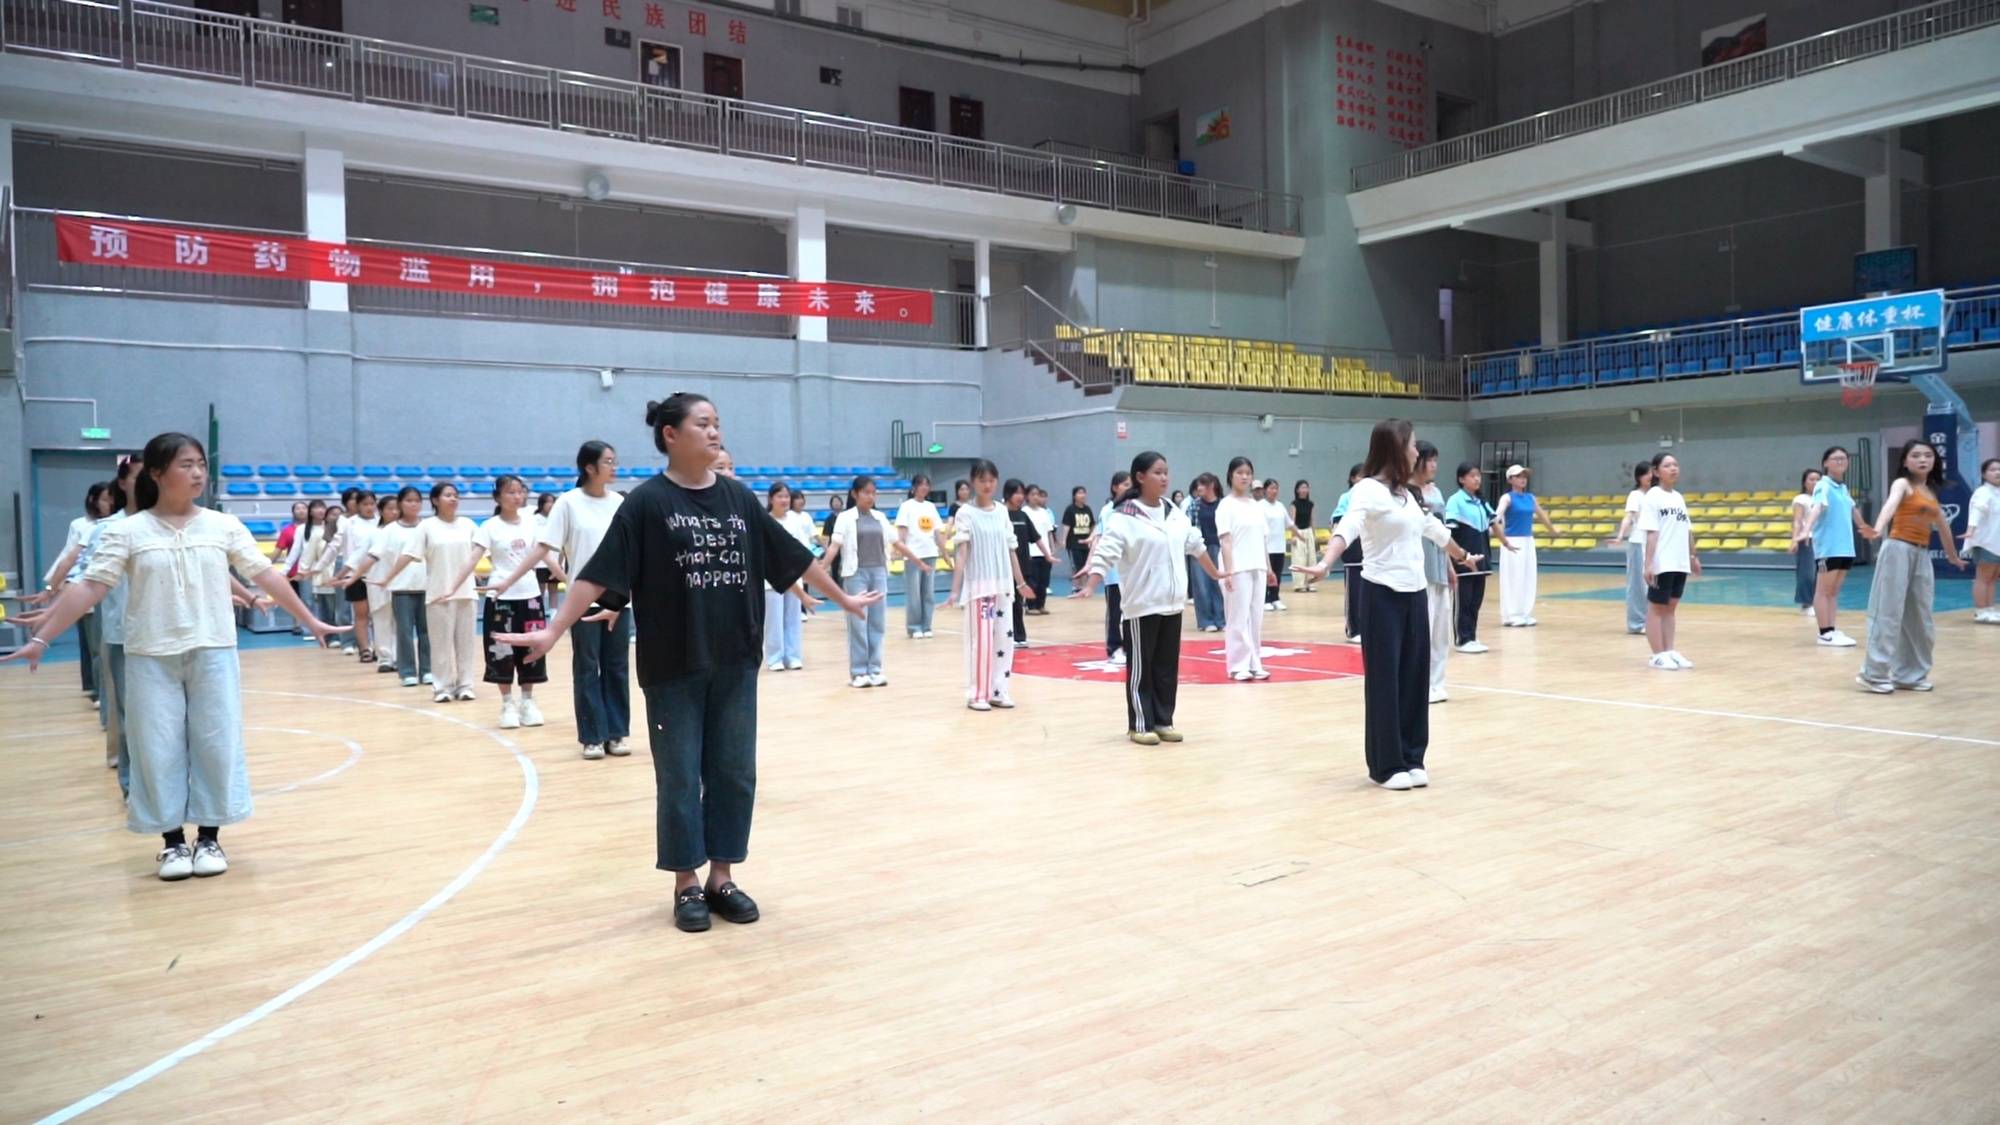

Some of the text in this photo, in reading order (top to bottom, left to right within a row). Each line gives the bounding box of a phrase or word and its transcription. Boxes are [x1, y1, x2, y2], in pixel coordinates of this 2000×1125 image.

[521, 0, 747, 45] 进民族团结
[1814, 304, 1925, 333] 健康体重杯
[692, 529, 738, 546] best
[675, 549, 717, 567] that
